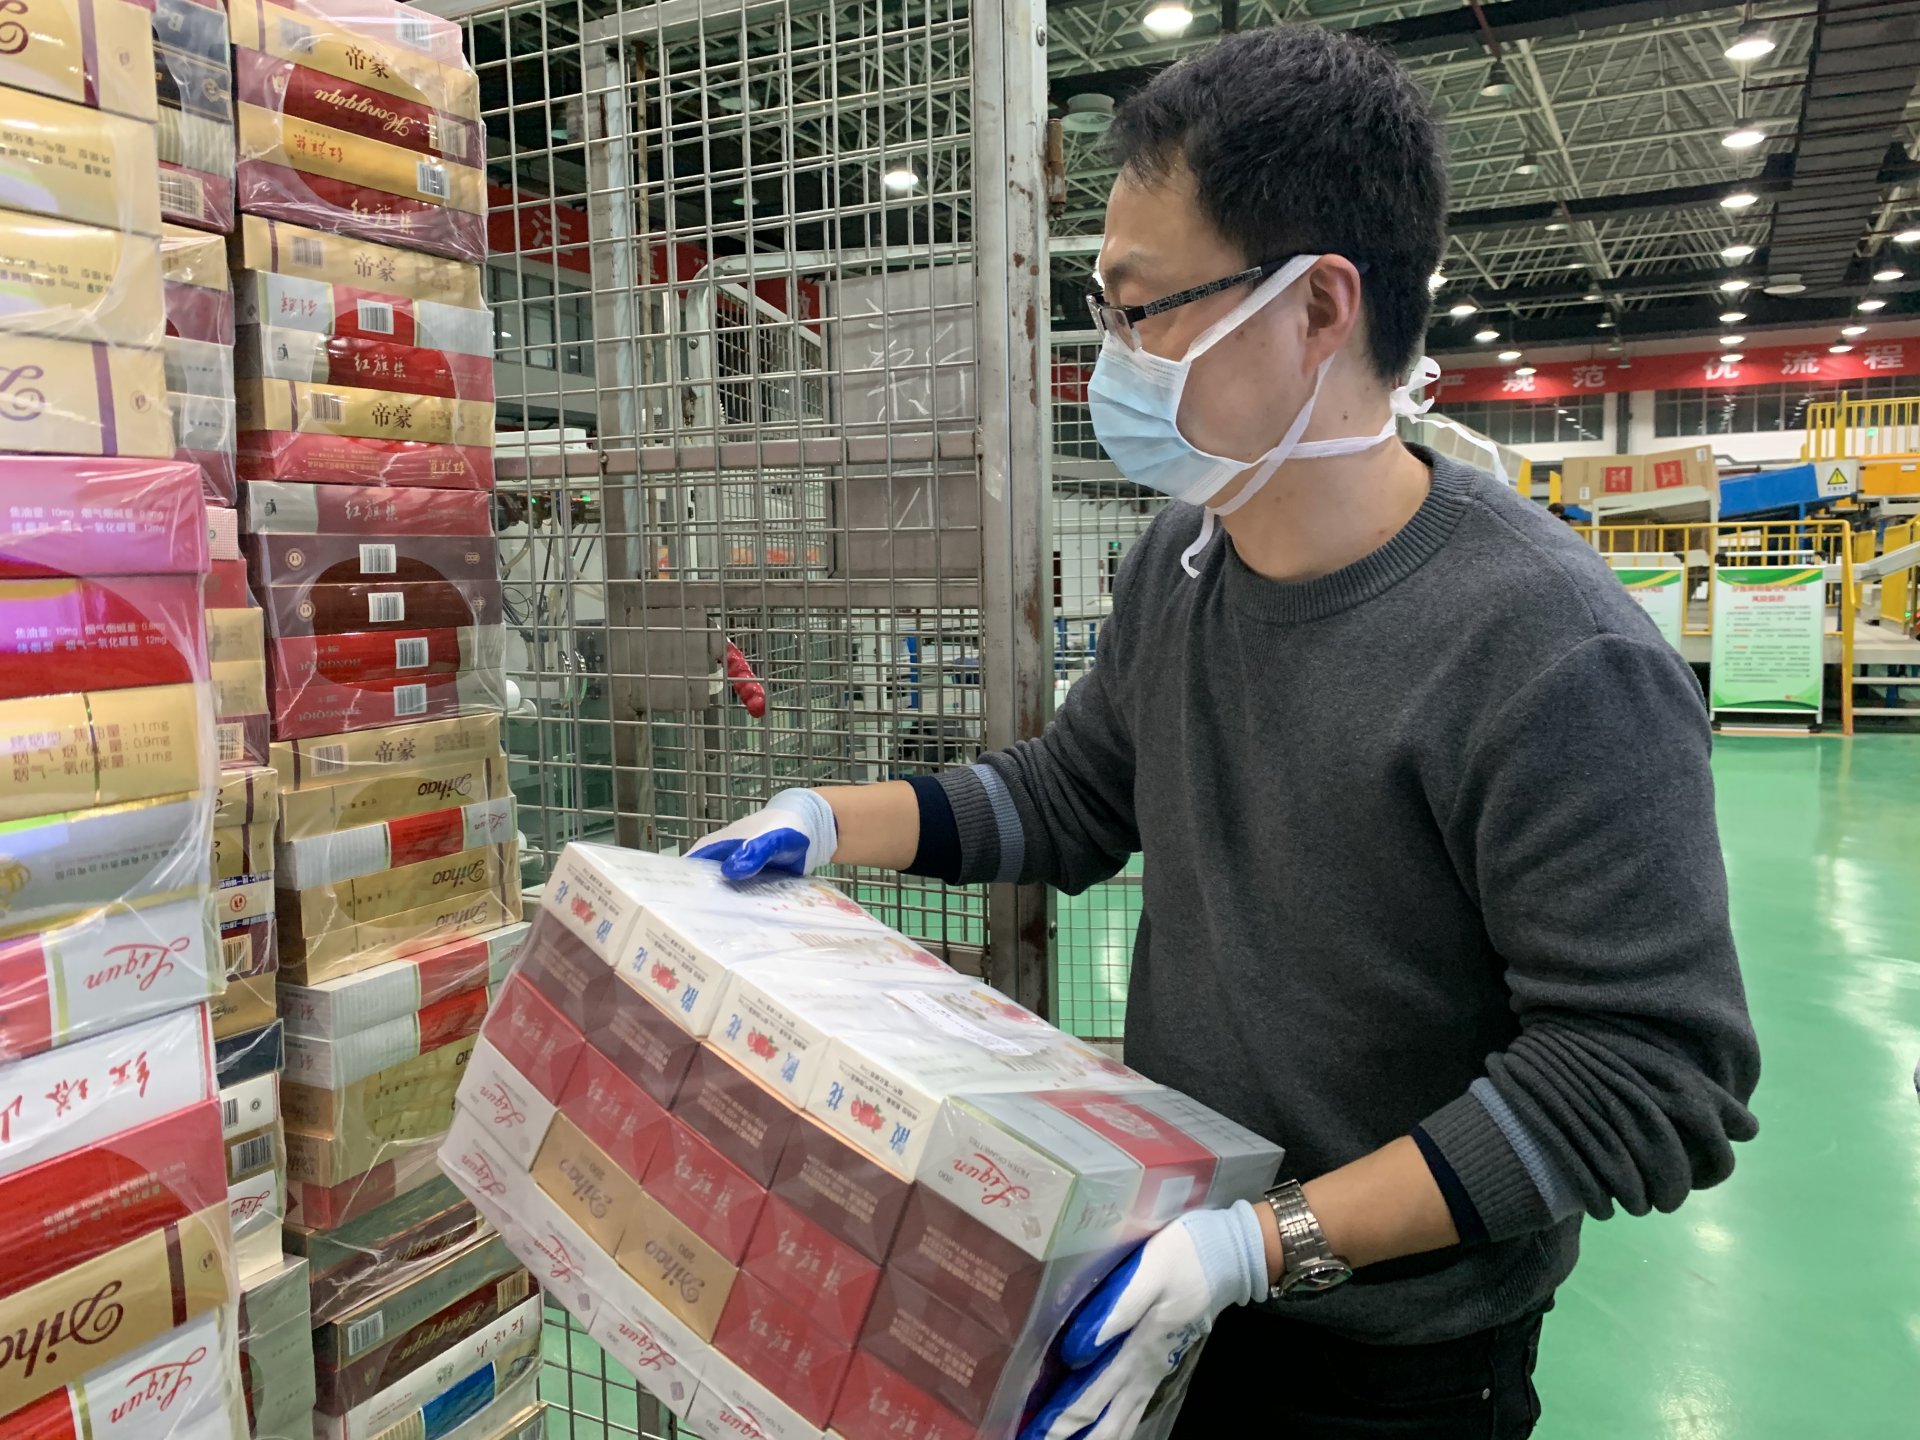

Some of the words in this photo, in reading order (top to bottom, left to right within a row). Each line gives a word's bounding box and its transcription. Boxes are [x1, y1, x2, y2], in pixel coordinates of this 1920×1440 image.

[314, 88, 413, 137] Hongqiqu
[372, 402, 413, 430] 帝豪
[375, 738, 416, 763] 帝豪
[417, 773, 472, 799] Dihao
[432, 859, 485, 888] Dihao
[83, 937, 190, 991] Liqun
[480, 1083, 527, 1132] Liqun
[826, 1081, 845, 1111] 花
[952, 1153, 1031, 1208] Liqun
[645, 1239, 706, 1305] Dihao
[107, 1347, 208, 1423] Liqun
